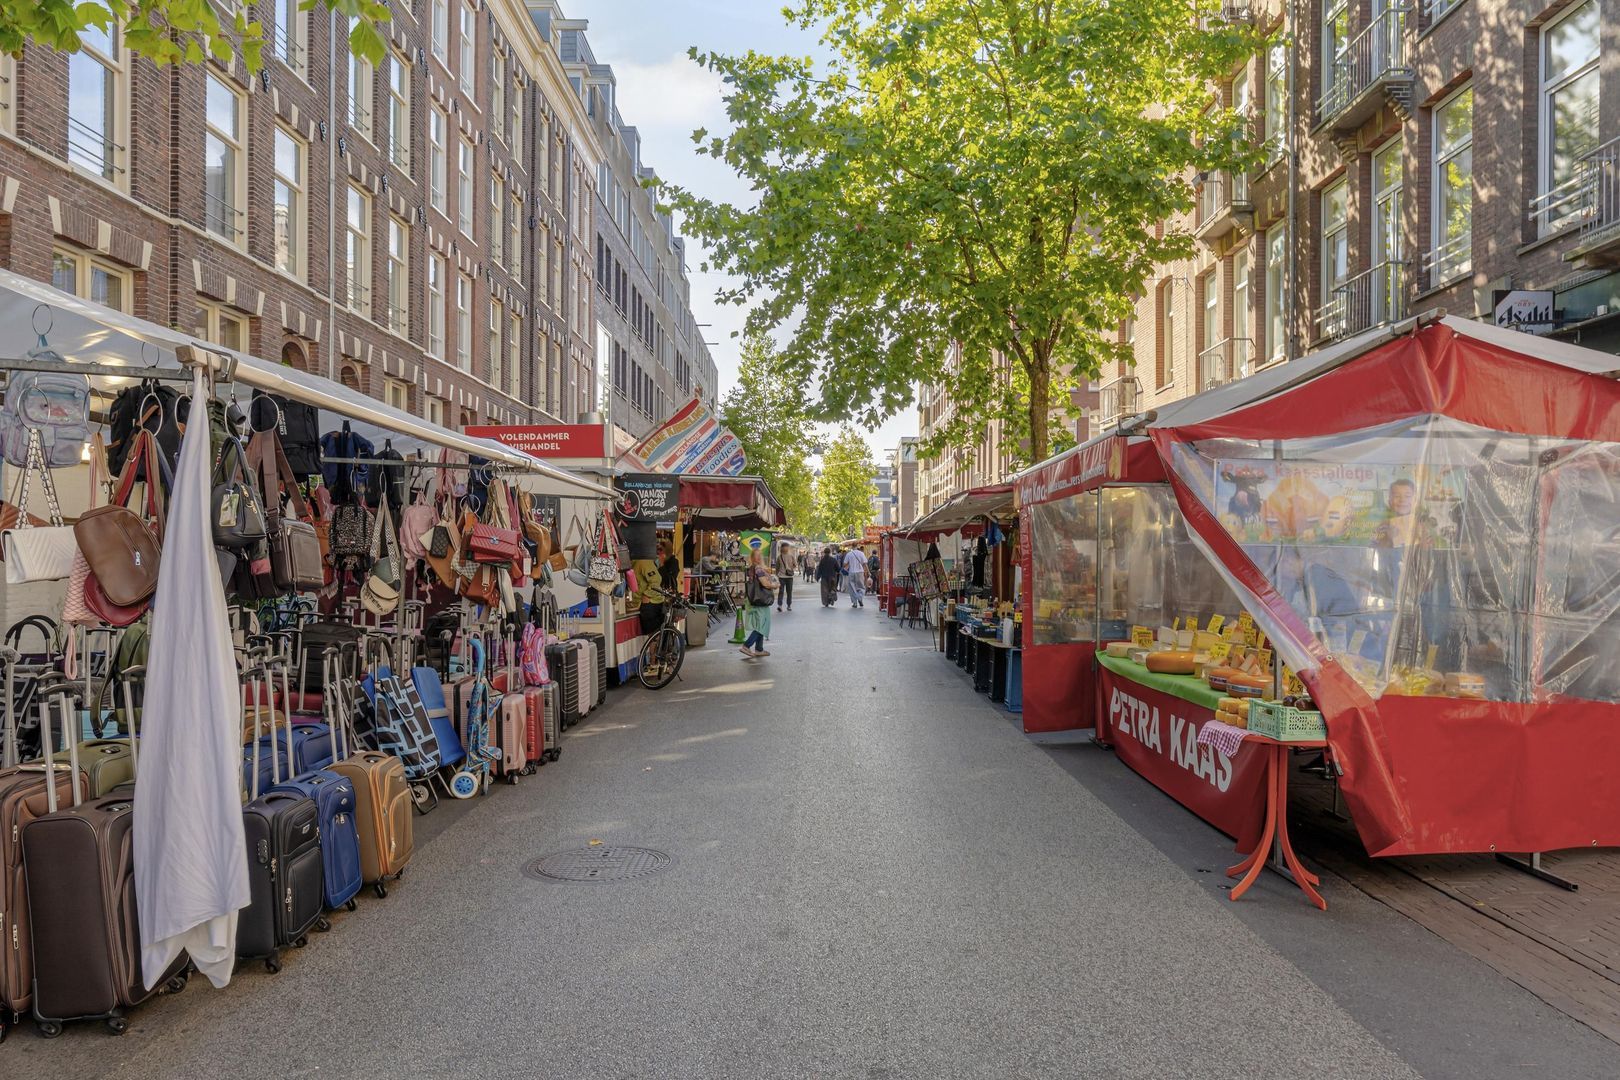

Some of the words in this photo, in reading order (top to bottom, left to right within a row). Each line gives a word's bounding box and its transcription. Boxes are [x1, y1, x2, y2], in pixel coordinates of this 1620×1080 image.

[1498, 305, 1549, 324] Asahi
[500, 432, 570, 441] VOLENDAMMER
[509, 442, 561, 451] VISHANDEL
[675, 432, 701, 457] HOLLANDSE
[638, 488, 669, 499] VANGST
[641, 498, 666, 508] 2026
[1110, 686, 1162, 755] PETRA
[1170, 714, 1232, 792] KAAS
